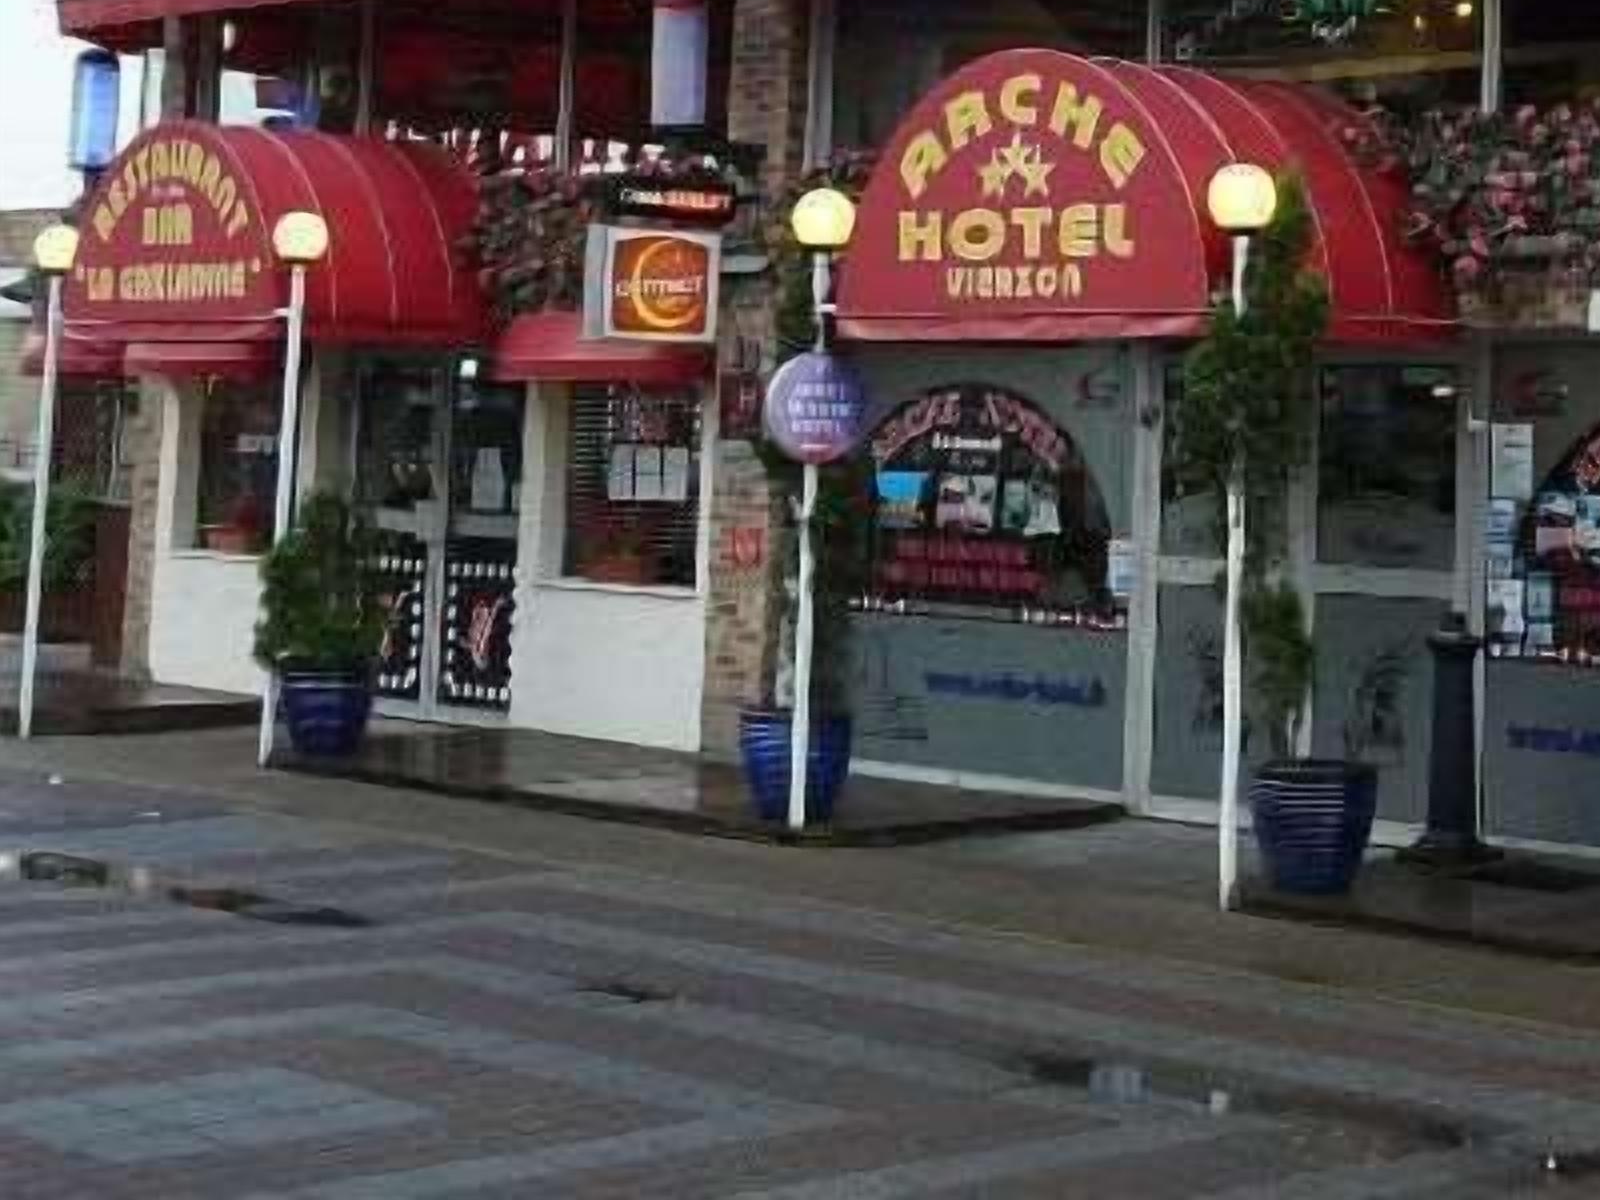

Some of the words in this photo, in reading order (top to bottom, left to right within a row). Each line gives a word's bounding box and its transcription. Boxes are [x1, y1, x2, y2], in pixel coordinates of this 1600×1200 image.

[900, 72, 1146, 200] ARCHE
[898, 203, 1135, 262] HOTEL
[946, 263, 1082, 299] VIERZON
